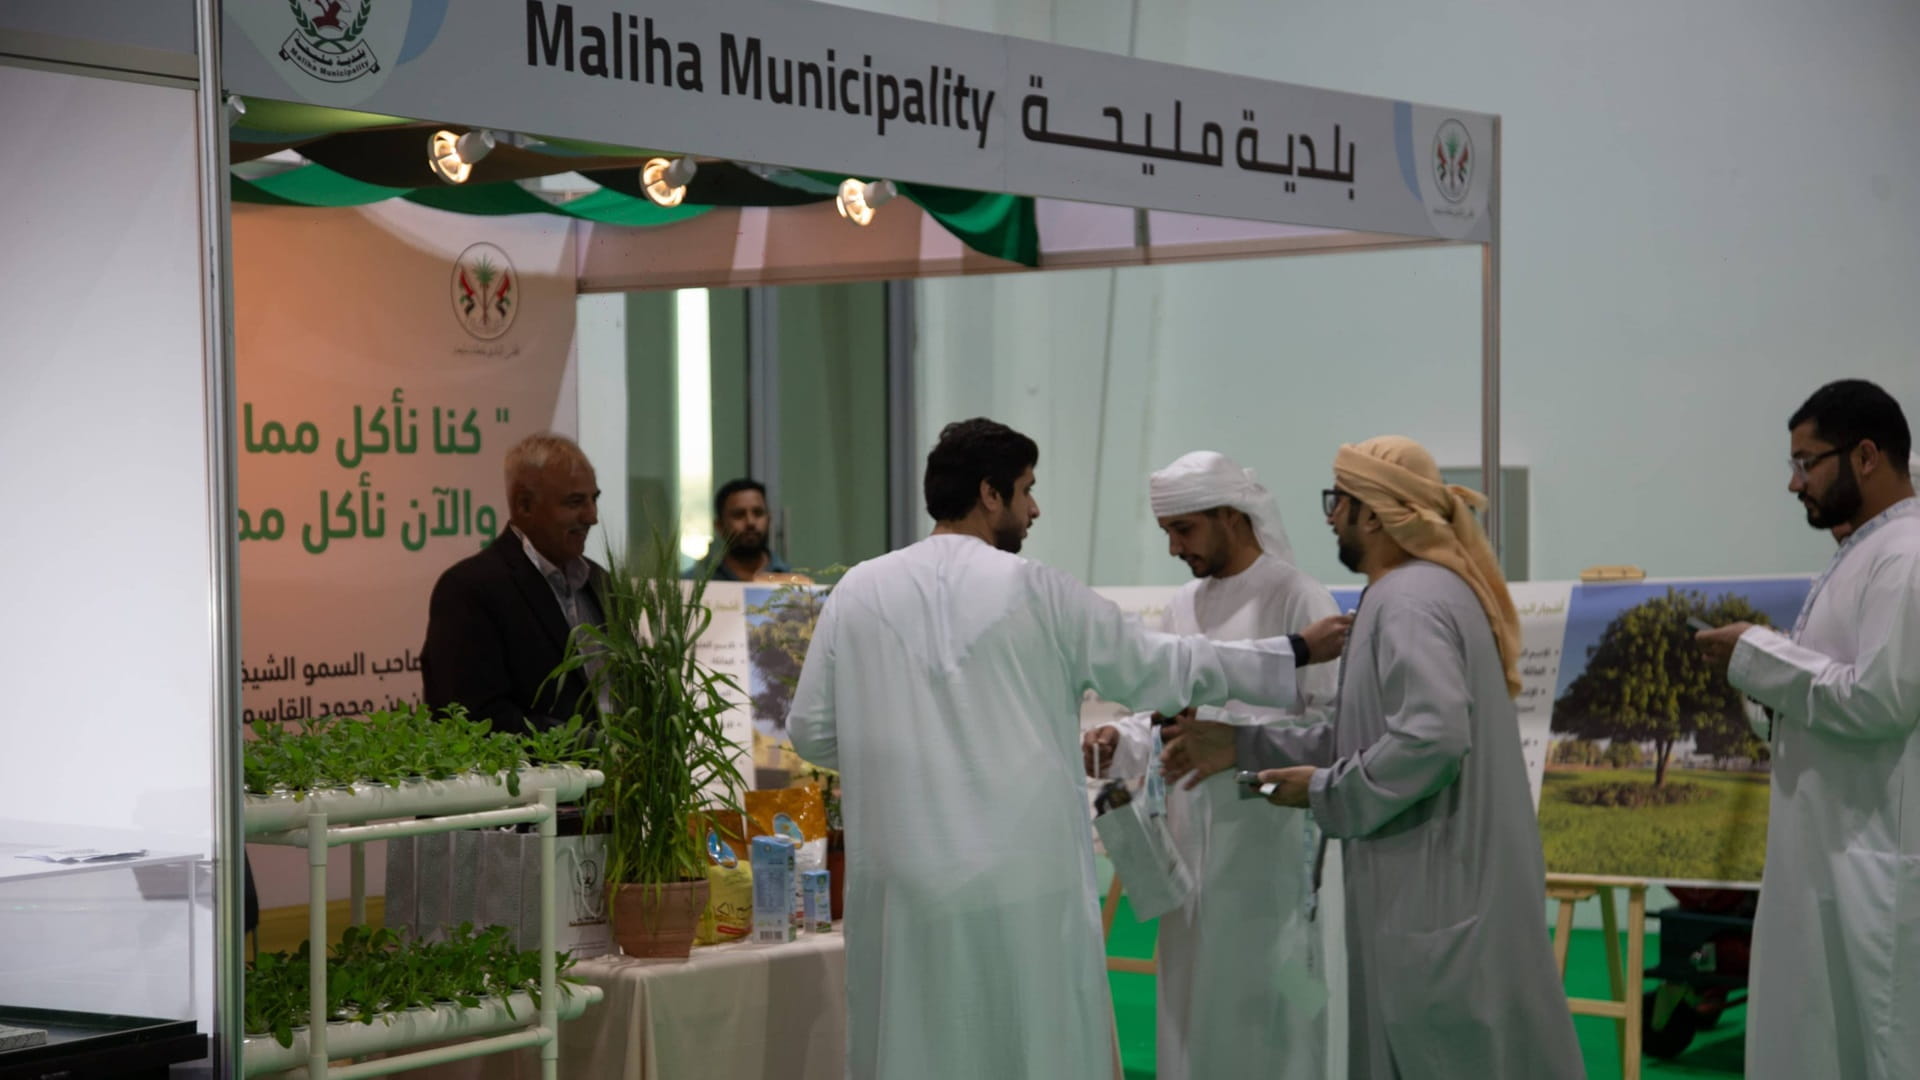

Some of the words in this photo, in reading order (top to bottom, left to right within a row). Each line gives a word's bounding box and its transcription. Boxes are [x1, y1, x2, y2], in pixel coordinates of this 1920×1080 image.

[290, 47, 317, 71] Maliha
[320, 60, 370, 77] Municipality
[527, 0, 703, 93] Maliha
[720, 32, 995, 149] Municipality
[1022, 75, 1224, 176] مليحة
[1236, 109, 1356, 200] بلدية
[243, 402, 320, 455] مما
[335, 387, 418, 469] نأكل
[433, 406, 482, 455] كنا
[238, 507, 285, 542] مم
[302, 471, 386, 555] نأكل
[401, 486, 497, 552] والآن
[302, 651, 365, 686] السمو
[243, 695, 312, 725] القاسم
[319, 698, 374, 718] محمد
